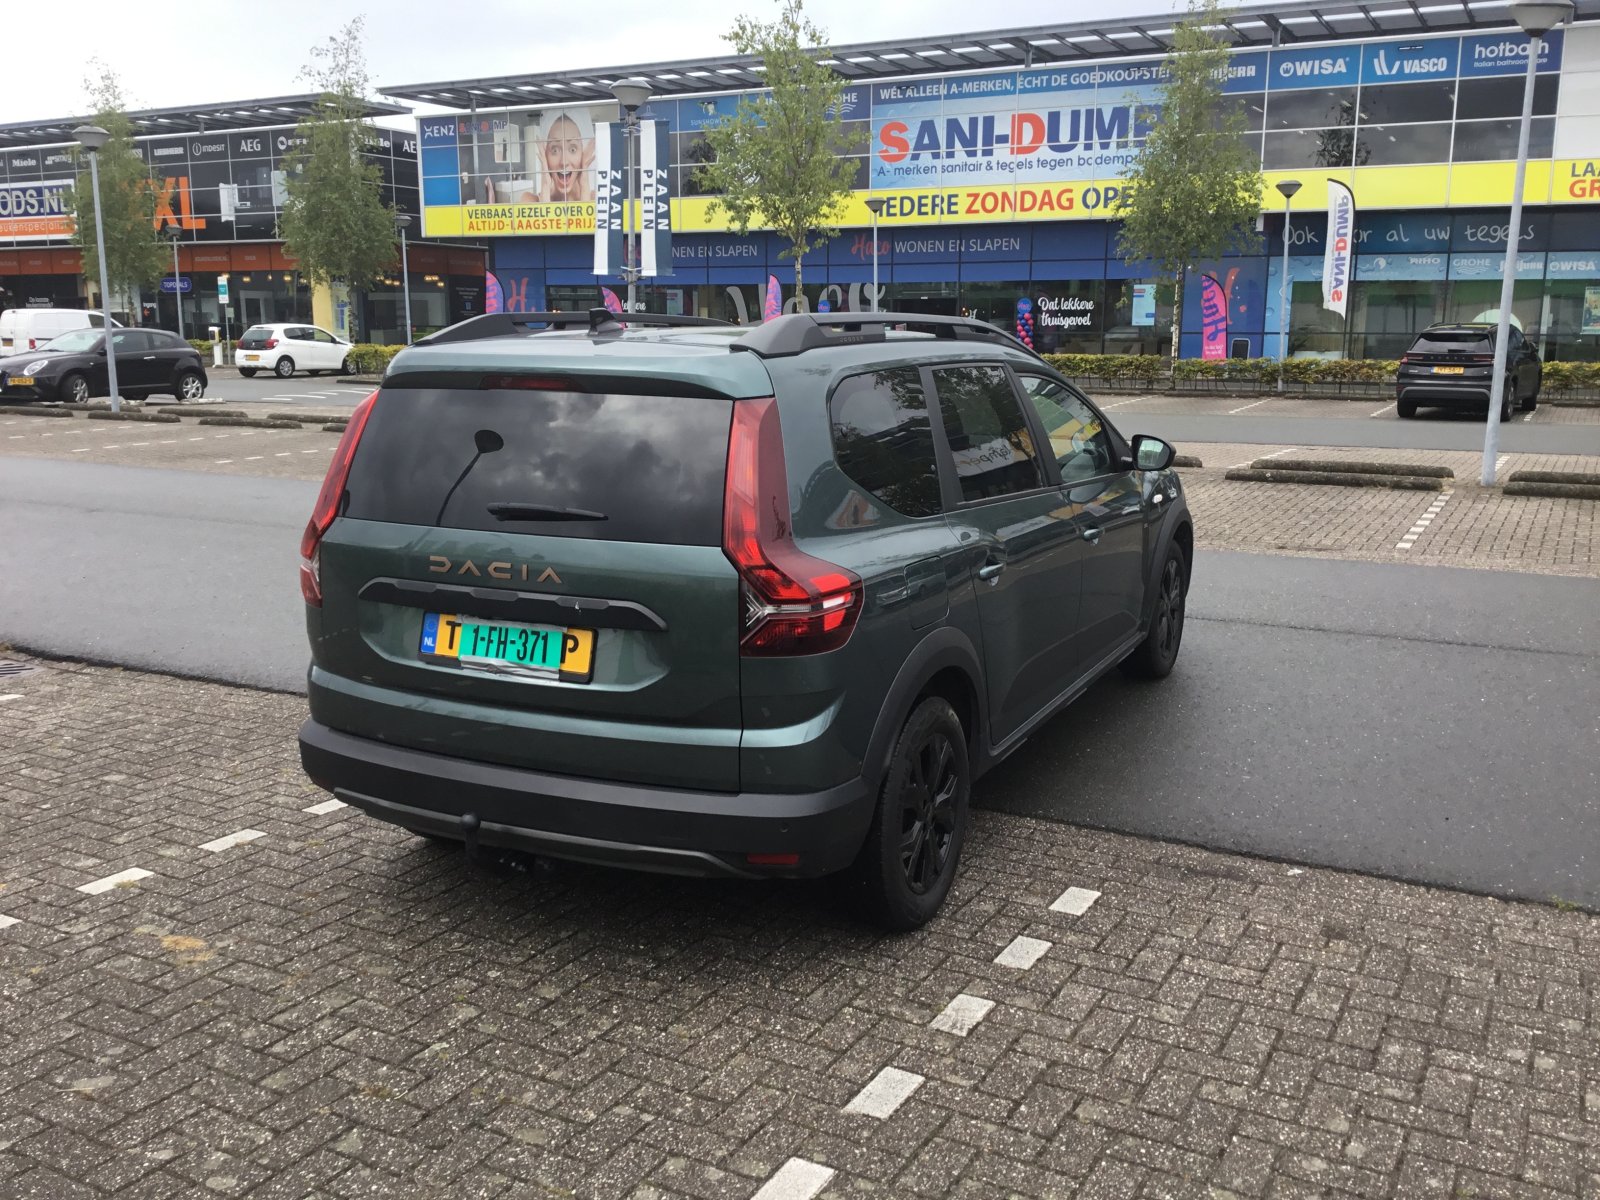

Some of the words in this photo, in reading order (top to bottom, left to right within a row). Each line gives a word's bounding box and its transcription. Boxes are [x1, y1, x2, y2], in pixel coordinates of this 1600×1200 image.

[1474, 41, 1549, 59] hotbah
[1403, 57, 1448, 74] VASCO
[880, 87, 903, 100] WÉL
[905, 84, 948, 98] ALLEEN
[950, 79, 1014, 94] A-MERKEN,
[1017, 74, 1049, 89] ÉCHT
[1051, 73, 1068, 87] DE
[878, 105, 1168, 163] SANI-DUMP
[240, 139, 261, 152] AEG
[12, 158, 37, 168] Miele
[893, 162, 938, 176] merken
[941, 160, 983, 174] sanitair
[985, 160, 994, 171] &
[996, 157, 1034, 173] tegels
[1036, 156, 1073, 171] tegen
[1077, 154, 1134, 167] bodemp
[597, 170, 608, 230] PLEIN
[610, 170, 622, 230] ZAAN
[643, 169, 654, 230] PLEIN
[656, 169, 669, 230] ZAAN
[965, 188, 1074, 214] ZONDAG
[1081, 186, 1135, 210] OPE
[468, 208, 513, 219] VERBAAS
[516, 207, 551, 218] JEZELF
[554, 206, 583, 216] OVER
[583, 205, 594, 216] O
[1282, 225, 1319, 245] Ook
[1386, 223, 1410, 242] al
[1424, 227, 1450, 241] uw
[1464, 223, 1536, 244] teges
[671, 246, 695, 258] NEN
[698, 246, 713, 257] EN
[715, 245, 758, 257] SLAPEN
[851, 233, 891, 261] Haco
[895, 240, 944, 253] WONEN
[949, 240, 965, 252] EN
[969, 238, 1020, 251] SLAPEN
[1453, 258, 1491, 267] GROHE
[1038, 296, 1060, 311] Dat
[1060, 297, 1094, 311] lekkere
[1041, 312, 1091, 329] thuisgevoel
[429, 555, 563, 584] DACIA
[423, 636, 435, 647] NL
[472, 624, 549, 664] 1-FH-371
